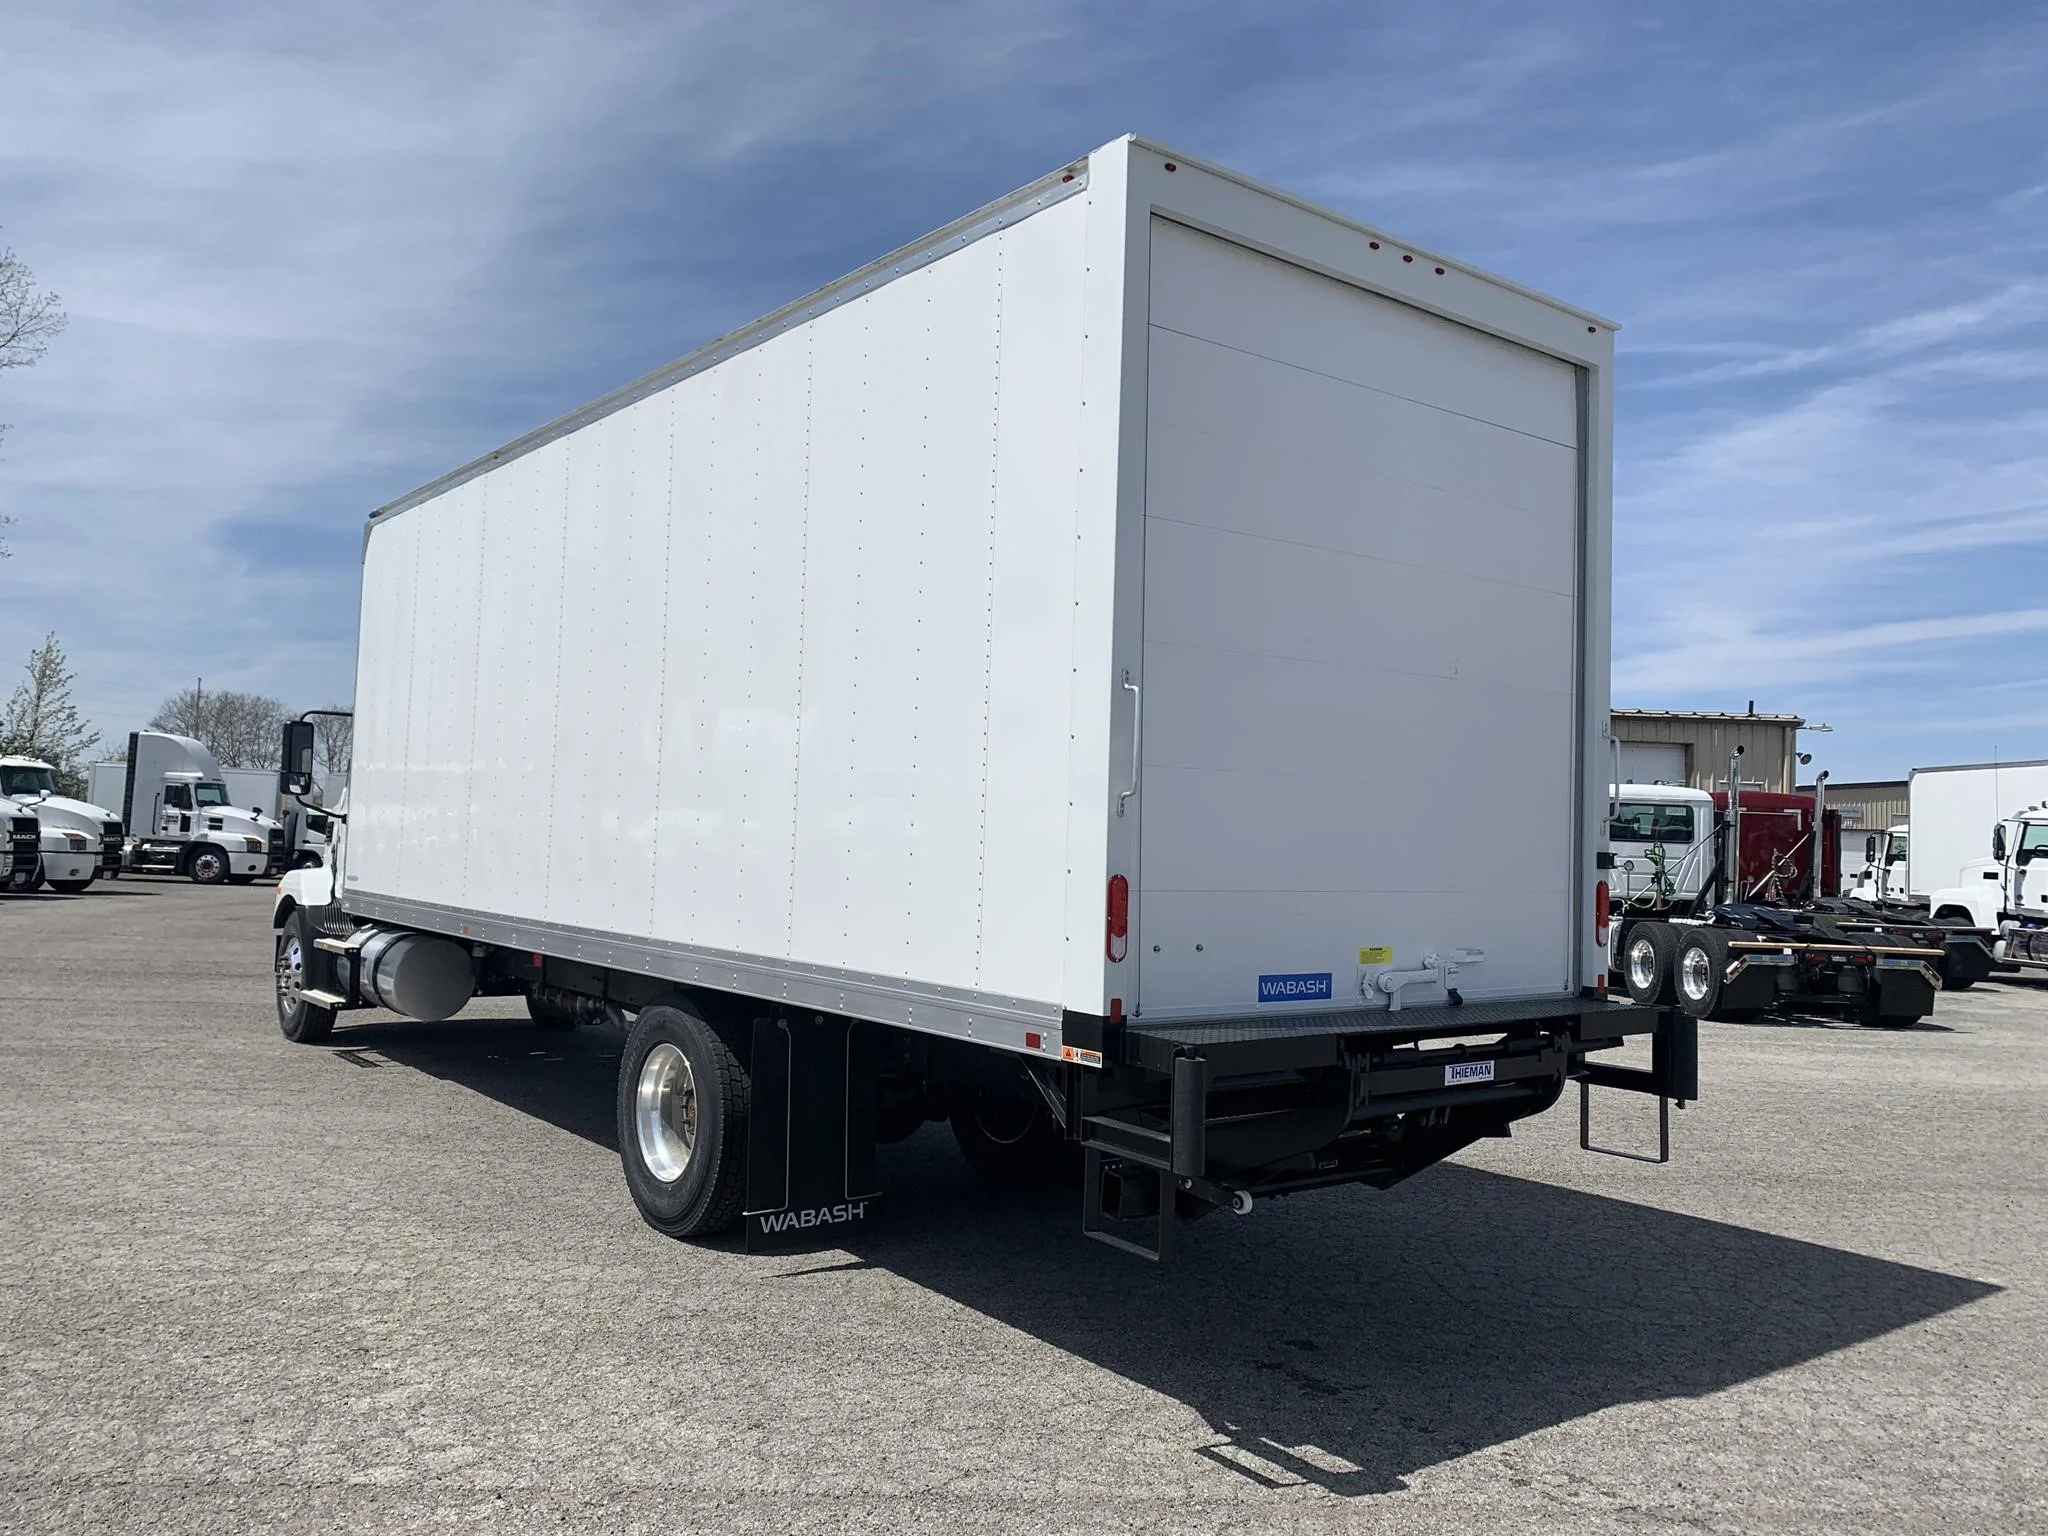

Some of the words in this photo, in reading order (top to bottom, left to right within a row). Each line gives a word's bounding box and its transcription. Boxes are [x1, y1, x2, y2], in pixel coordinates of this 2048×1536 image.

[1261, 980, 1326, 995] WABASH
[1449, 1063, 1491, 1080] THIEMAN
[760, 1202, 864, 1233] WABASH
